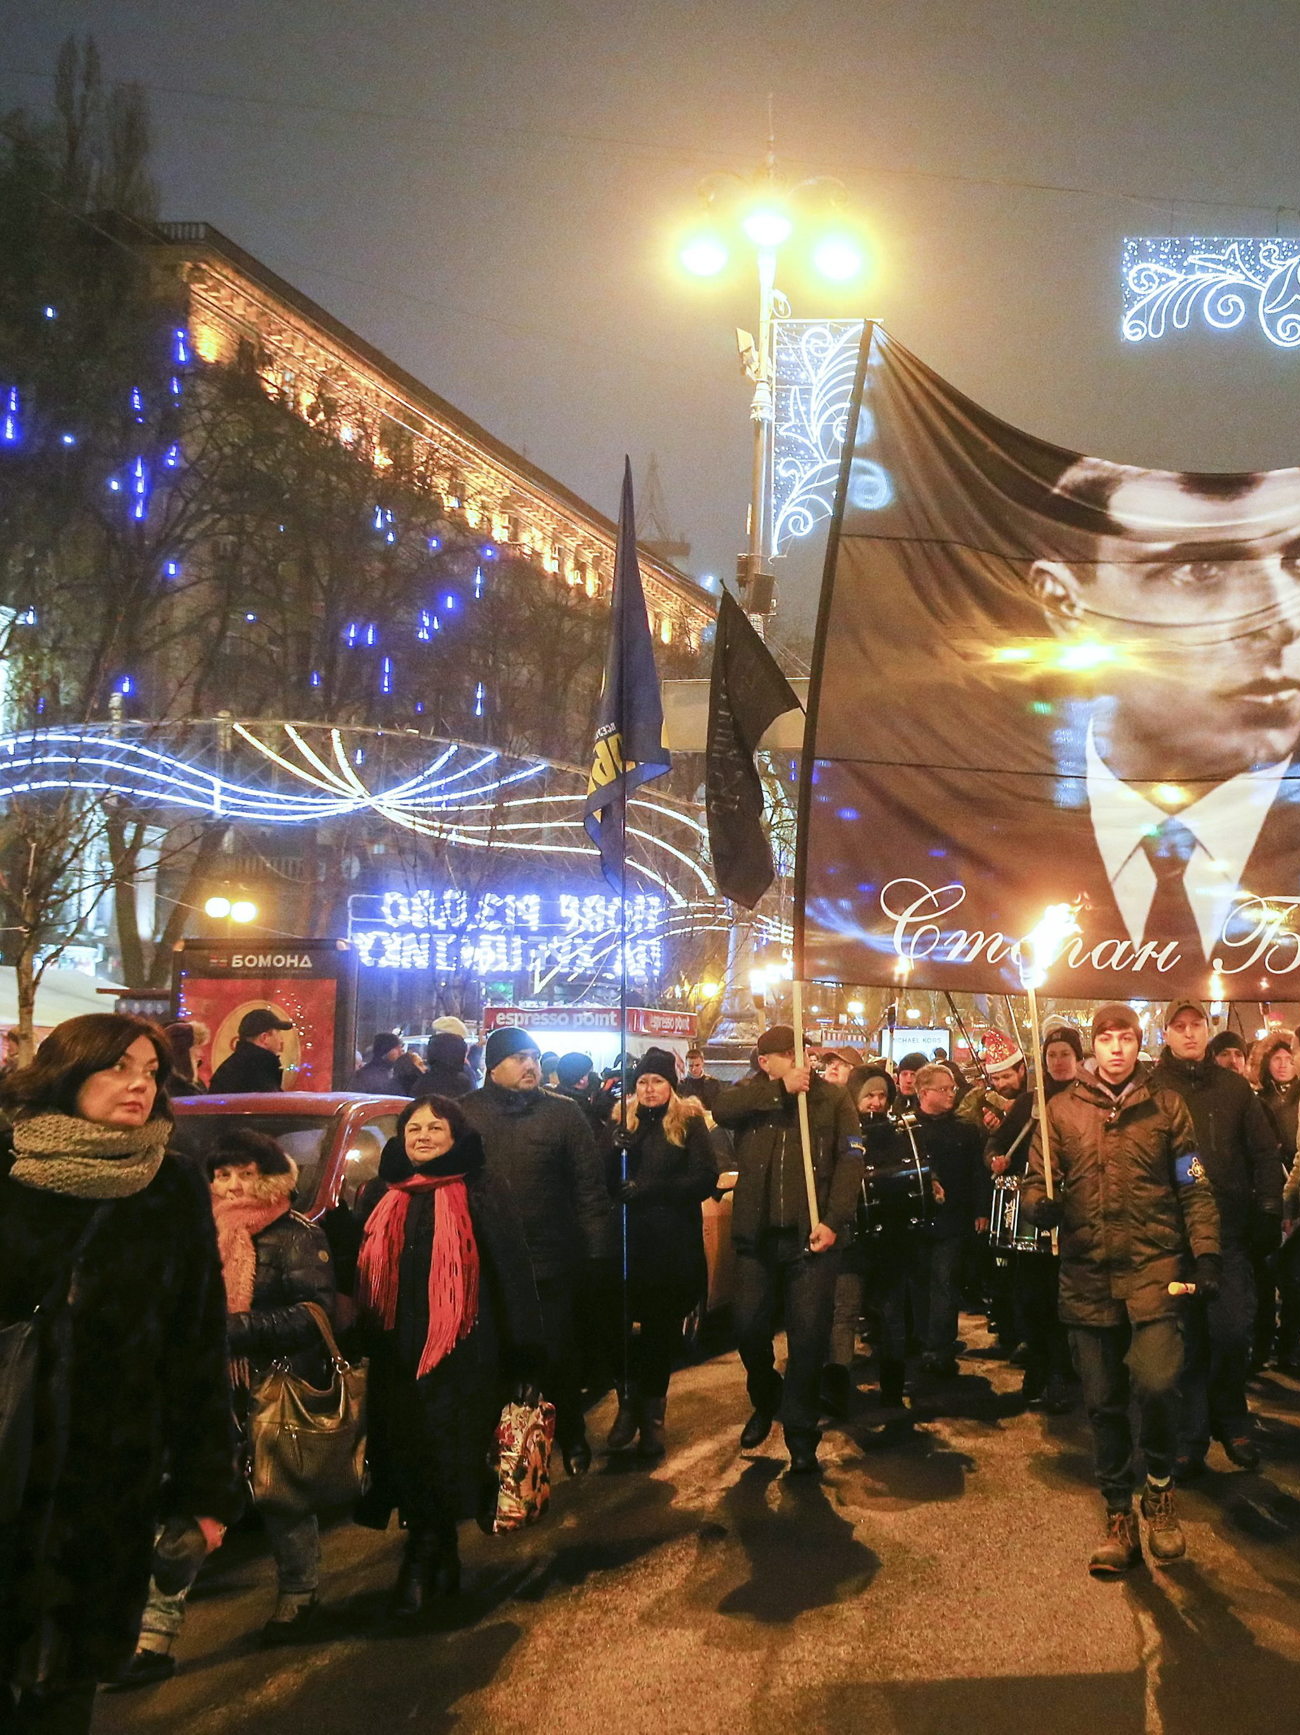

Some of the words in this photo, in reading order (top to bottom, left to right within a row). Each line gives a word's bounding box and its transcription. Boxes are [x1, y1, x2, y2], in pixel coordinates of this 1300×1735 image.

[231, 954, 313, 968] БОМОНД
[496, 1011, 569, 1027] espresso
[573, 1010, 617, 1027] point
